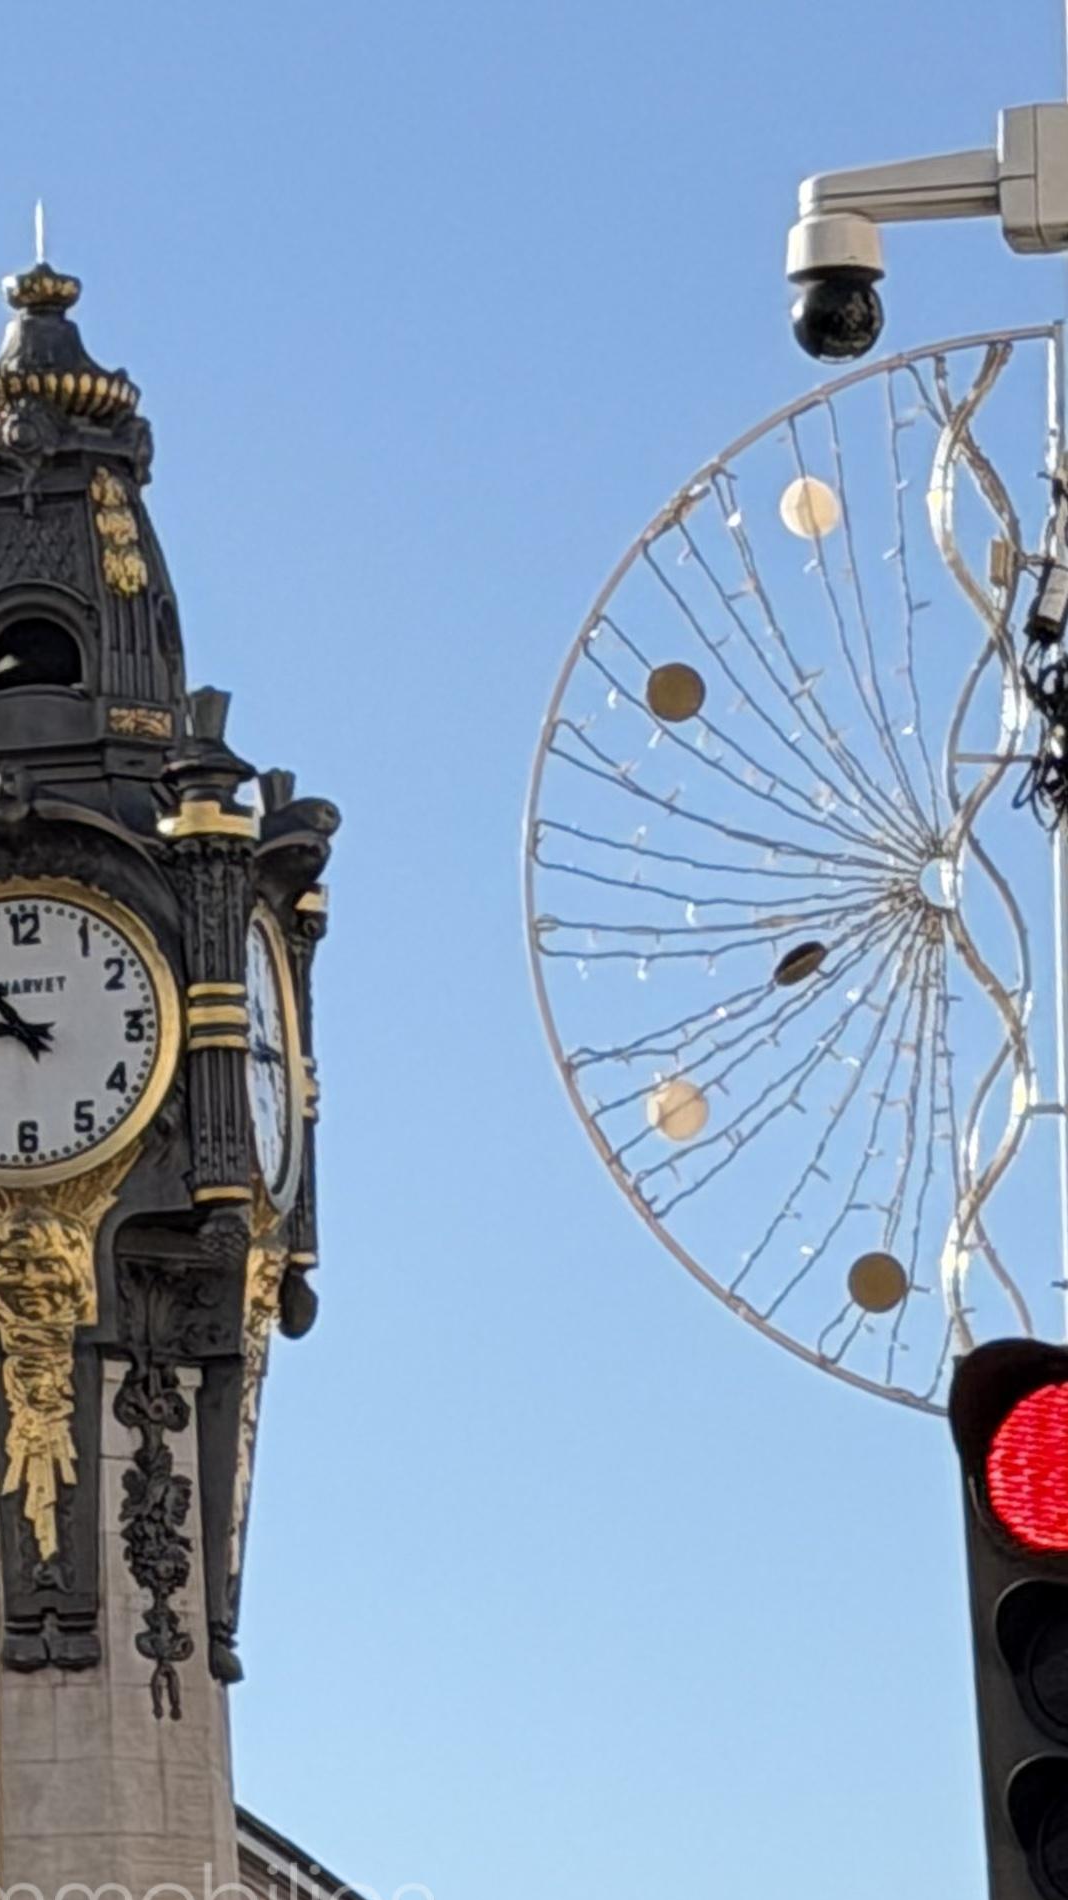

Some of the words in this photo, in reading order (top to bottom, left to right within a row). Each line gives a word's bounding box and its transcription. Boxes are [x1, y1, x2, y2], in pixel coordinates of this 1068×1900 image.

[9, 913, 40, 946] 12
[78, 918, 91, 957] 1
[104, 957, 126, 991] 2
[125, 1010, 146, 1043] 3
[105, 1062, 127, 1092] 4
[74, 1101, 95, 1133] 5
[17, 1121, 39, 1154] 6
